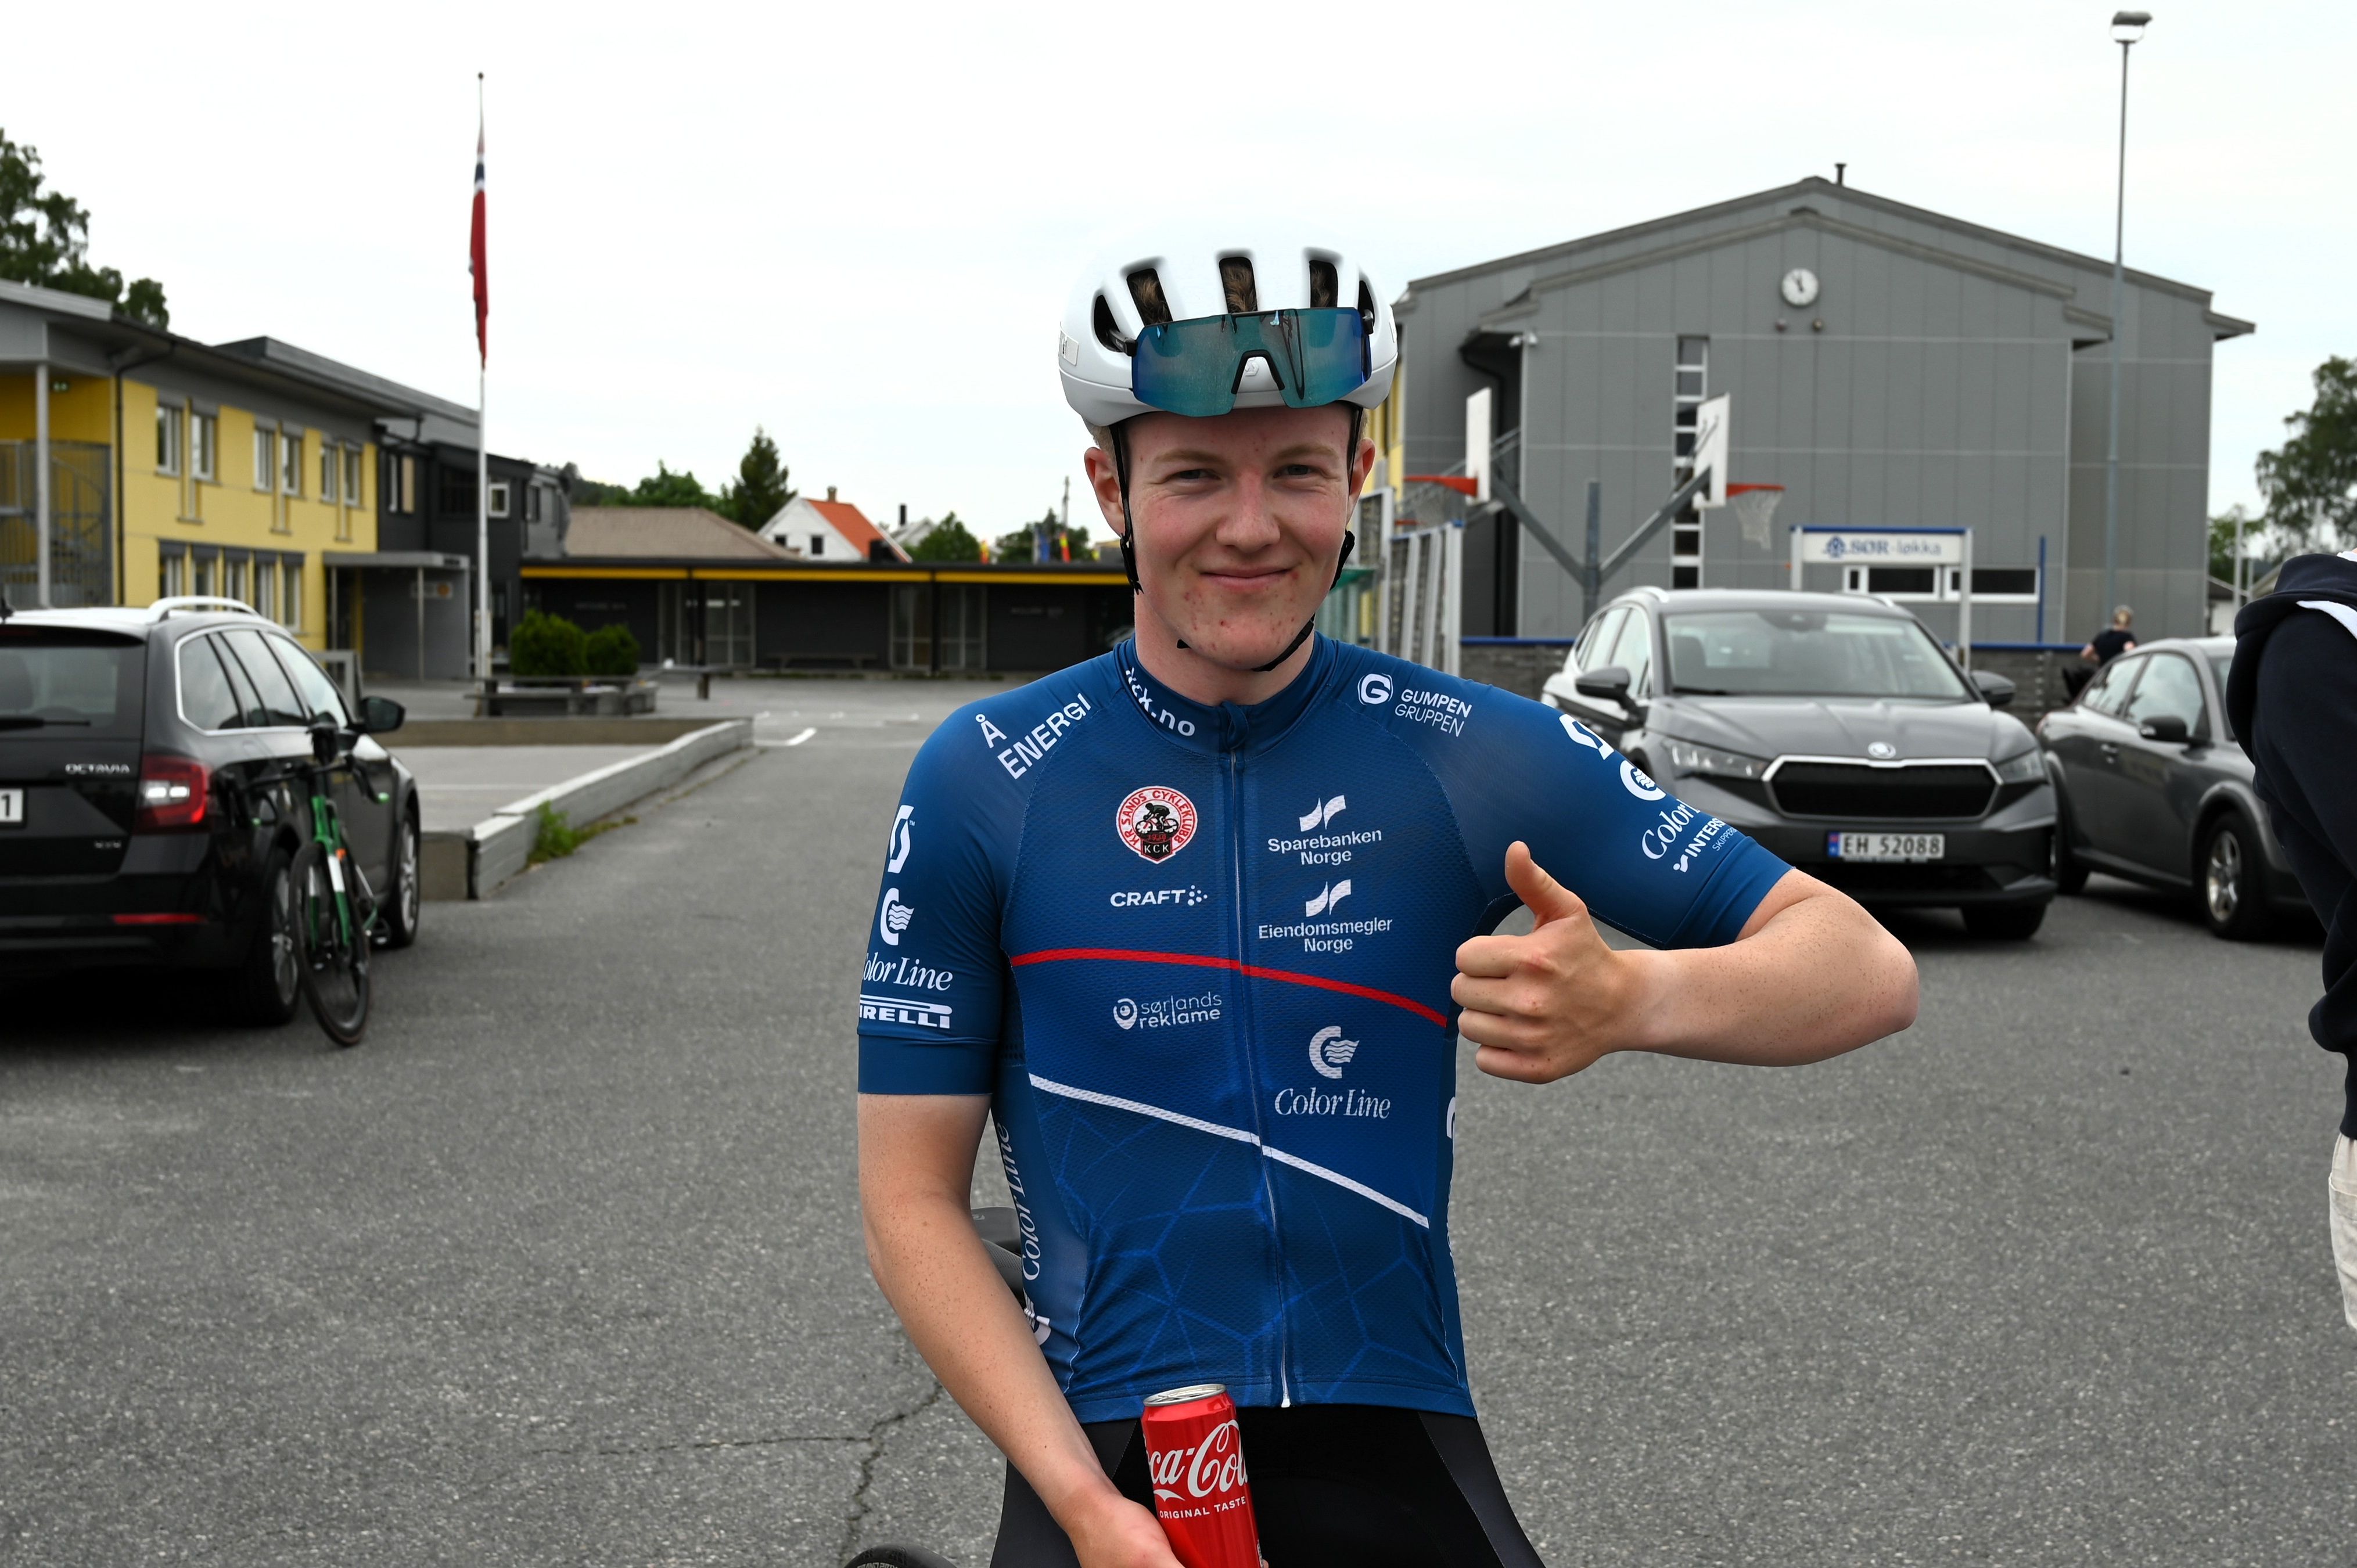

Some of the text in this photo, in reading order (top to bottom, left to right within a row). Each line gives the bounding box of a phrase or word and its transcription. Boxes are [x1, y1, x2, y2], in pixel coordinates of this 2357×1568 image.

[1400, 689, 1472, 718] GUMPEN
[976, 714, 1007, 748] Å
[1395, 704, 1464, 737] GRUPPEN
[997, 693, 1091, 779] ENERGI
[65, 764, 130, 775] OCTAVIA
[1122, 790, 1192, 845] KR SANDS CYKLEKLUBB
[1267, 829, 1382, 854] Sparebanken
[1642, 804, 1694, 859] Color
[1144, 844, 1169, 853] KCK
[1300, 850, 1352, 865] Norge
[1844, 837, 1940, 854] EH 52088
[1110, 890, 1186, 907] CRAFT
[1259, 918, 1393, 939] Eiendomsmegler
[1304, 935, 1353, 953] Norge
[863, 952, 953, 991] olor Line
[1141, 991, 1222, 1015] sørlands
[1140, 1008, 1221, 1029] reklame
[1274, 1087, 1391, 1119] Color Line
[997, 1123, 1041, 1281] Color Line
[1160, 1496, 1246, 1519] ORIGINAL TASTE
